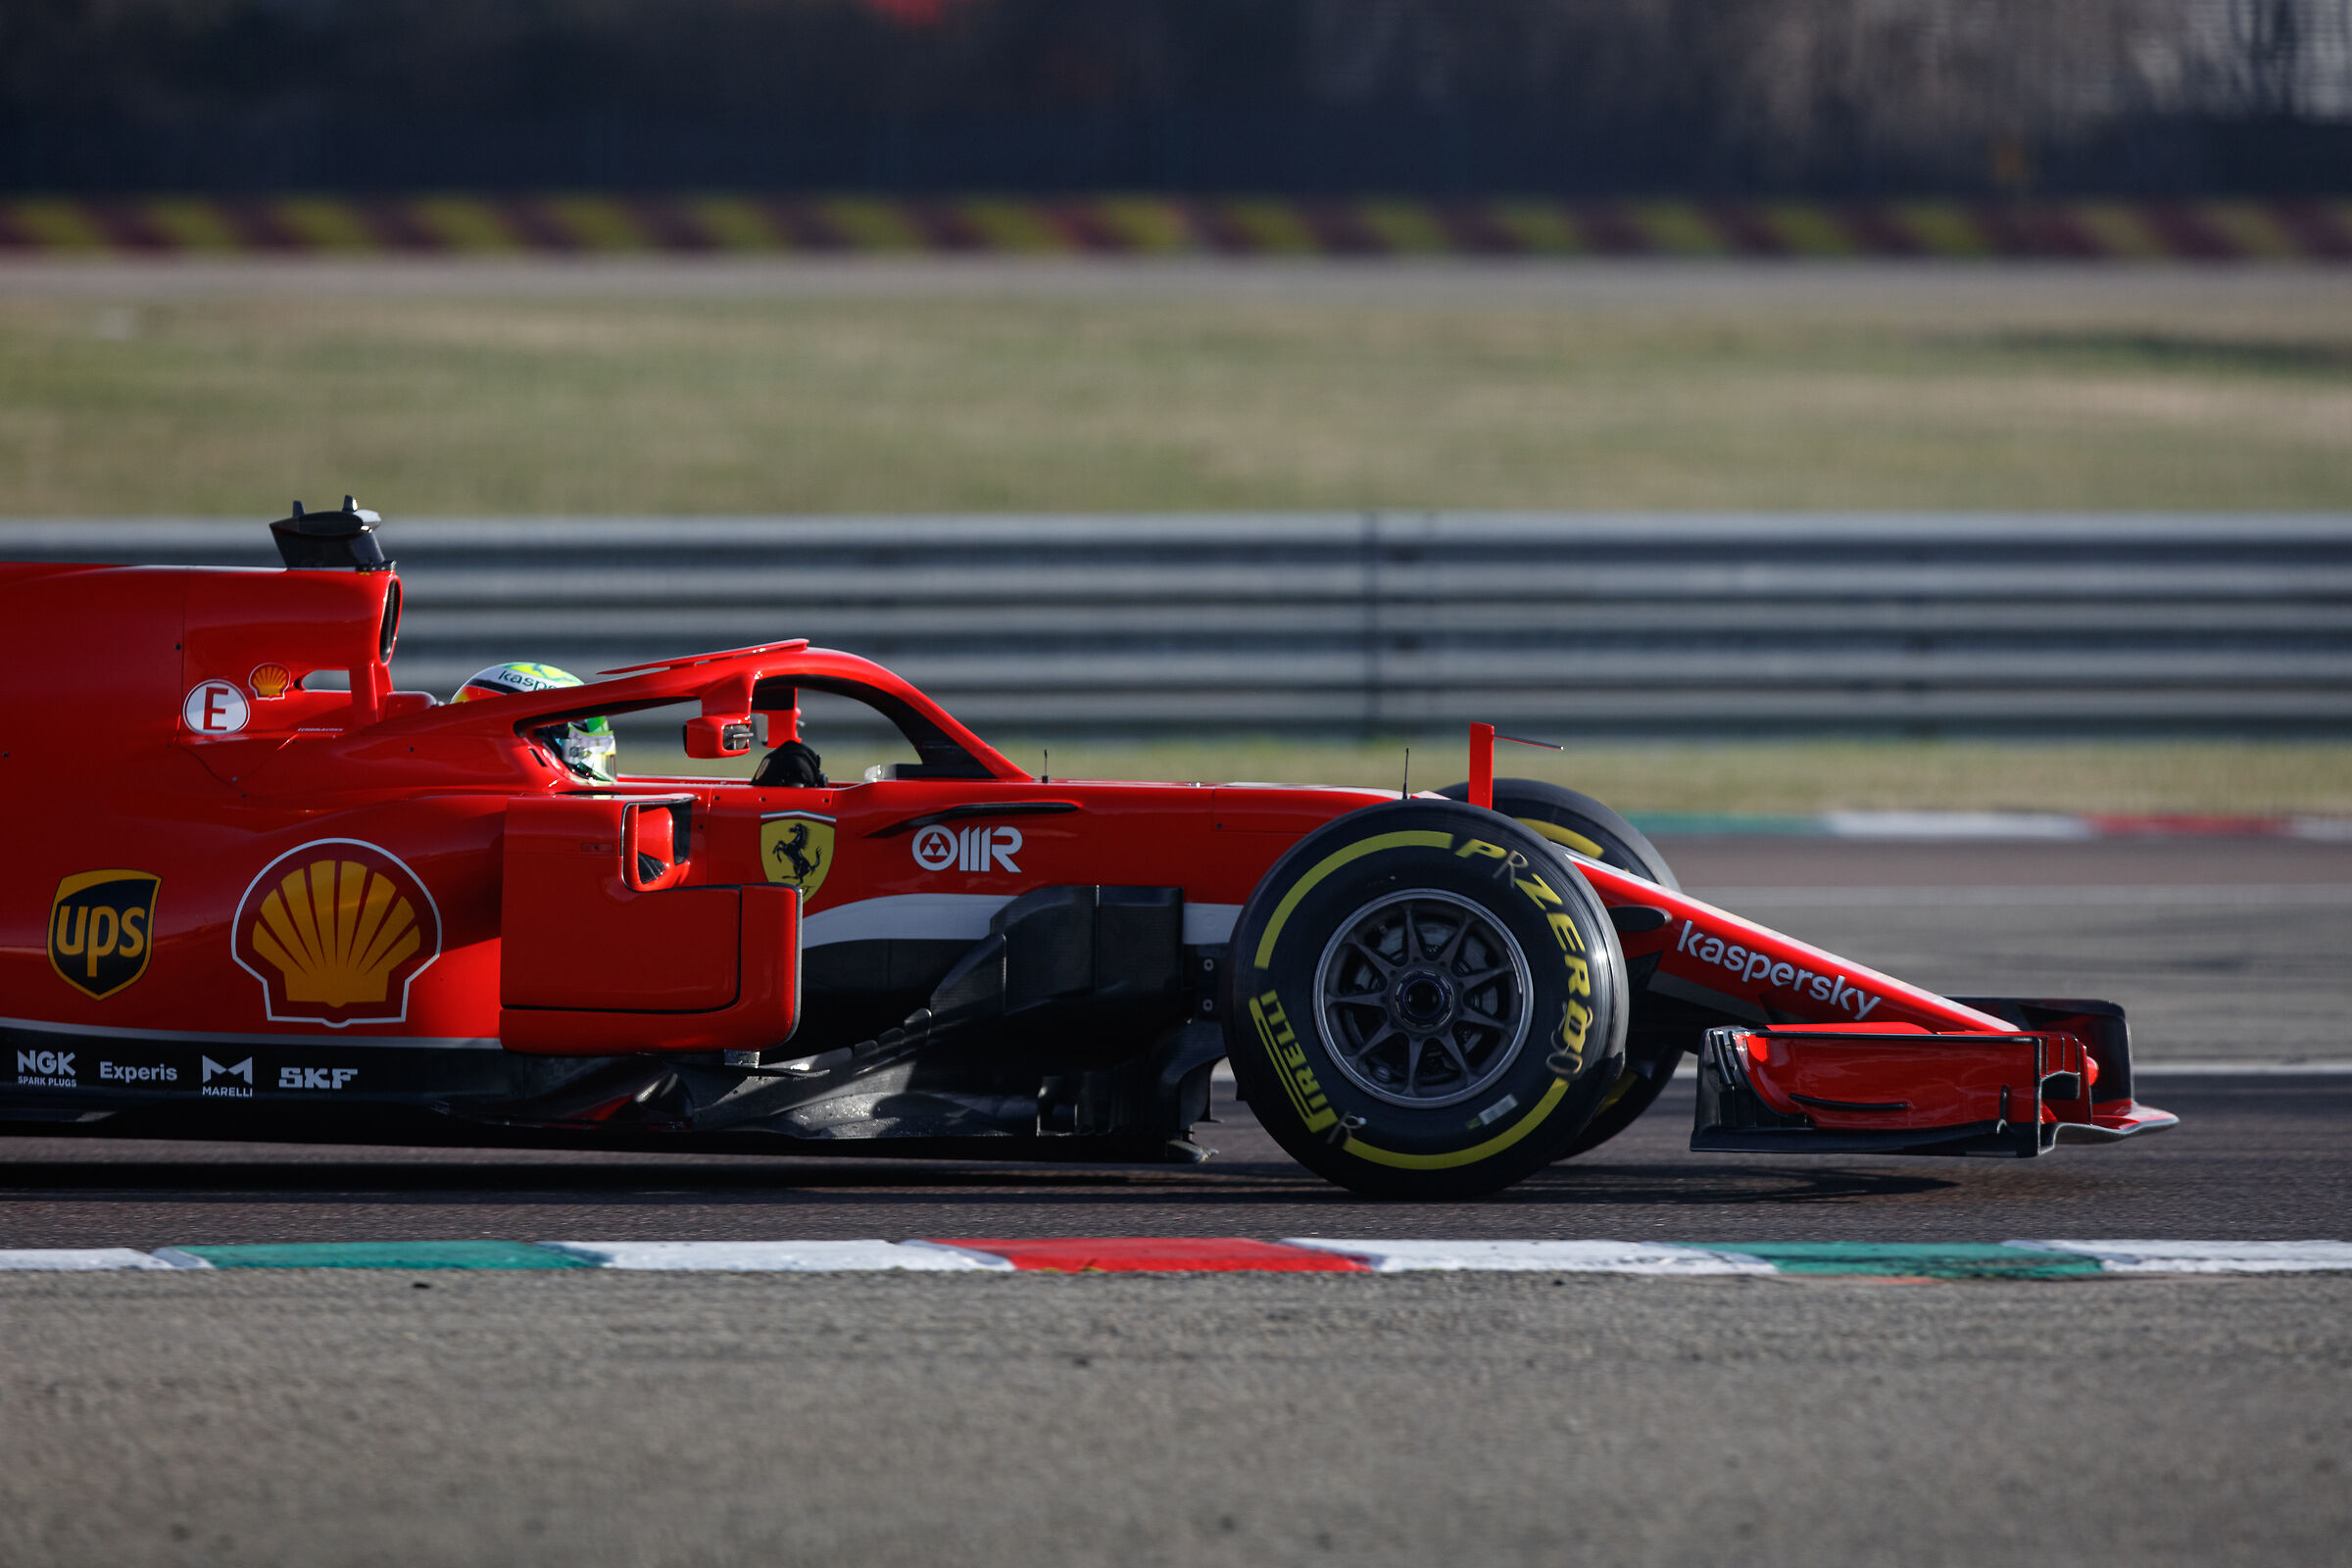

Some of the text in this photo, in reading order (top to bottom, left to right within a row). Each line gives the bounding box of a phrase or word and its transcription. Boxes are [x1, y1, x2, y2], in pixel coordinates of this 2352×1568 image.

[202, 686, 228, 731] E
[56, 905, 146, 977] ups
[1677, 920, 1882, 1021] kaspersky
[17, 1050, 76, 1077] NGK
[100, 1061, 178, 1083] Experis
[1249, 990, 1340, 1134] PIRELLI
[18, 1075, 77, 1088] SPARK PLUGS
[202, 1085, 253, 1098] MARELLI
[278, 1067, 359, 1090] SKF
